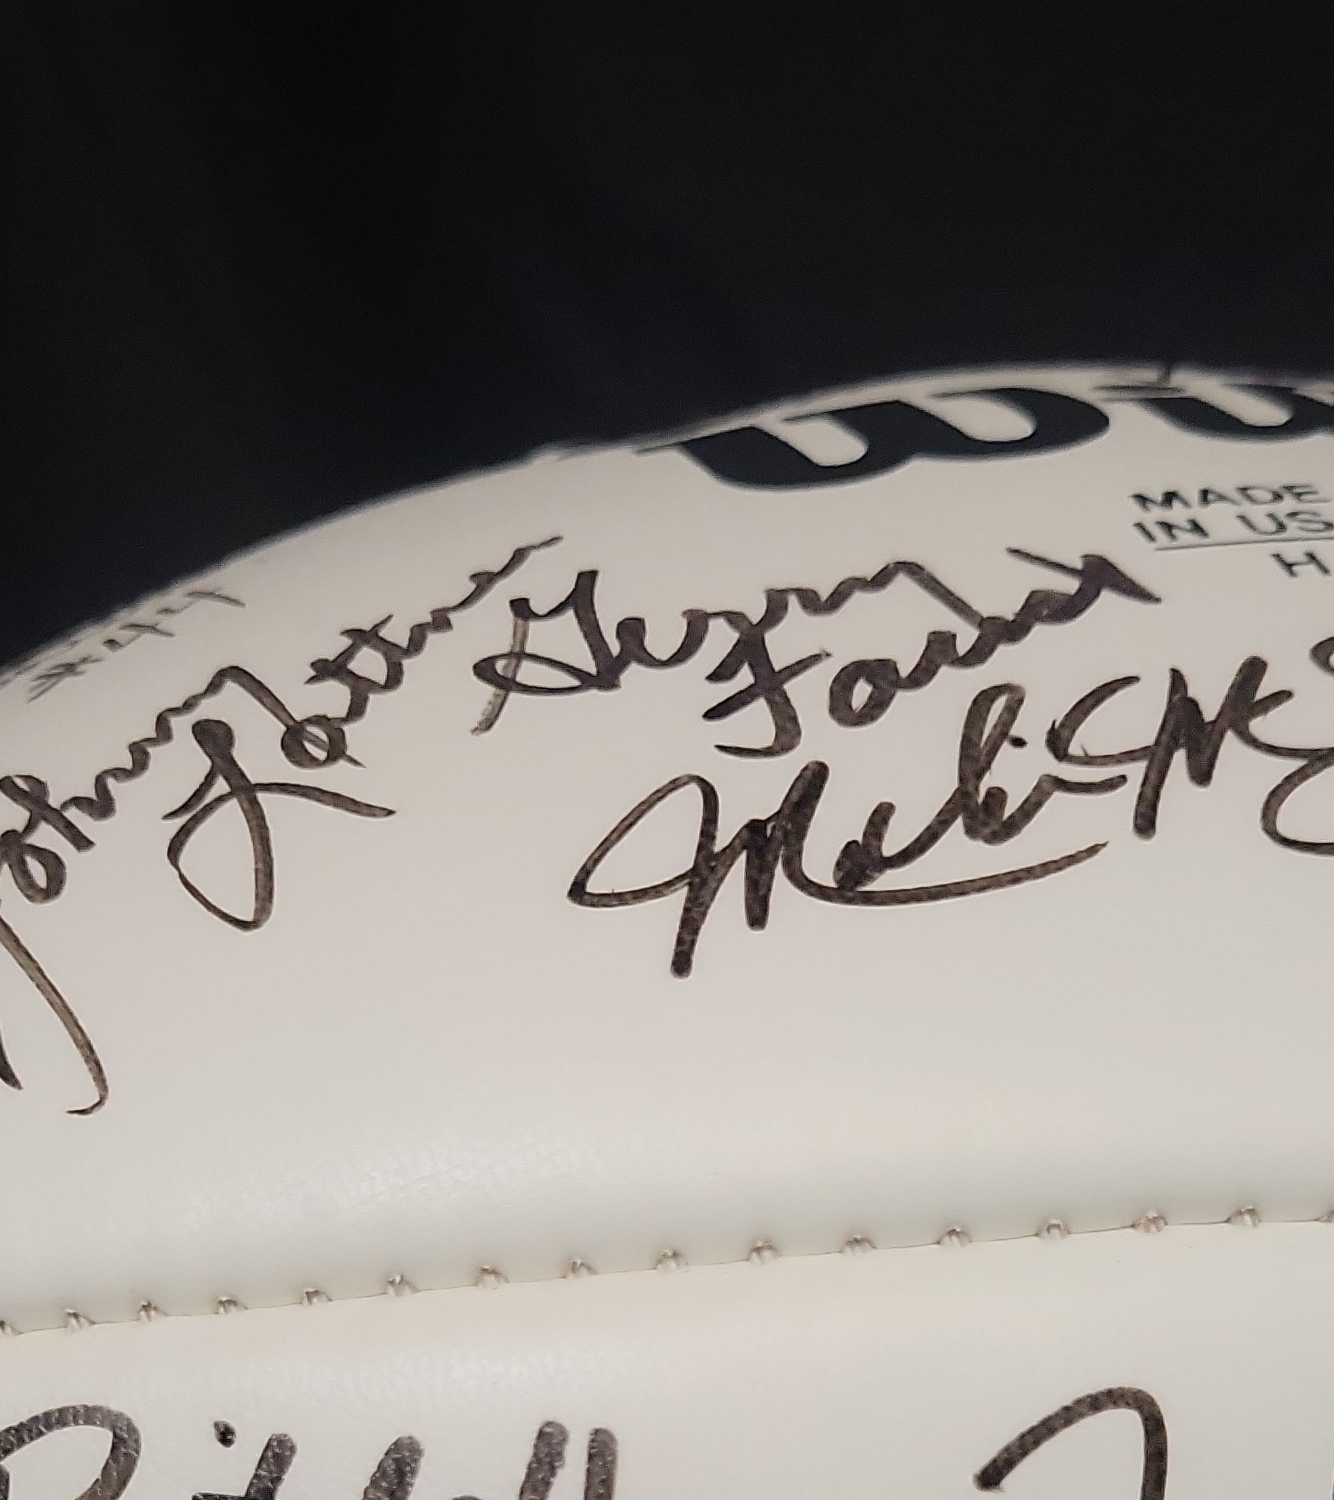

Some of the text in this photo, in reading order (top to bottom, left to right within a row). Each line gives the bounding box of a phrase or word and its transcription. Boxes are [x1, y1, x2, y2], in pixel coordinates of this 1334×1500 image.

[1128, 481, 1332, 512] MADE
[1131, 517, 1210, 545] IN
[1269, 550, 1332, 578] H
